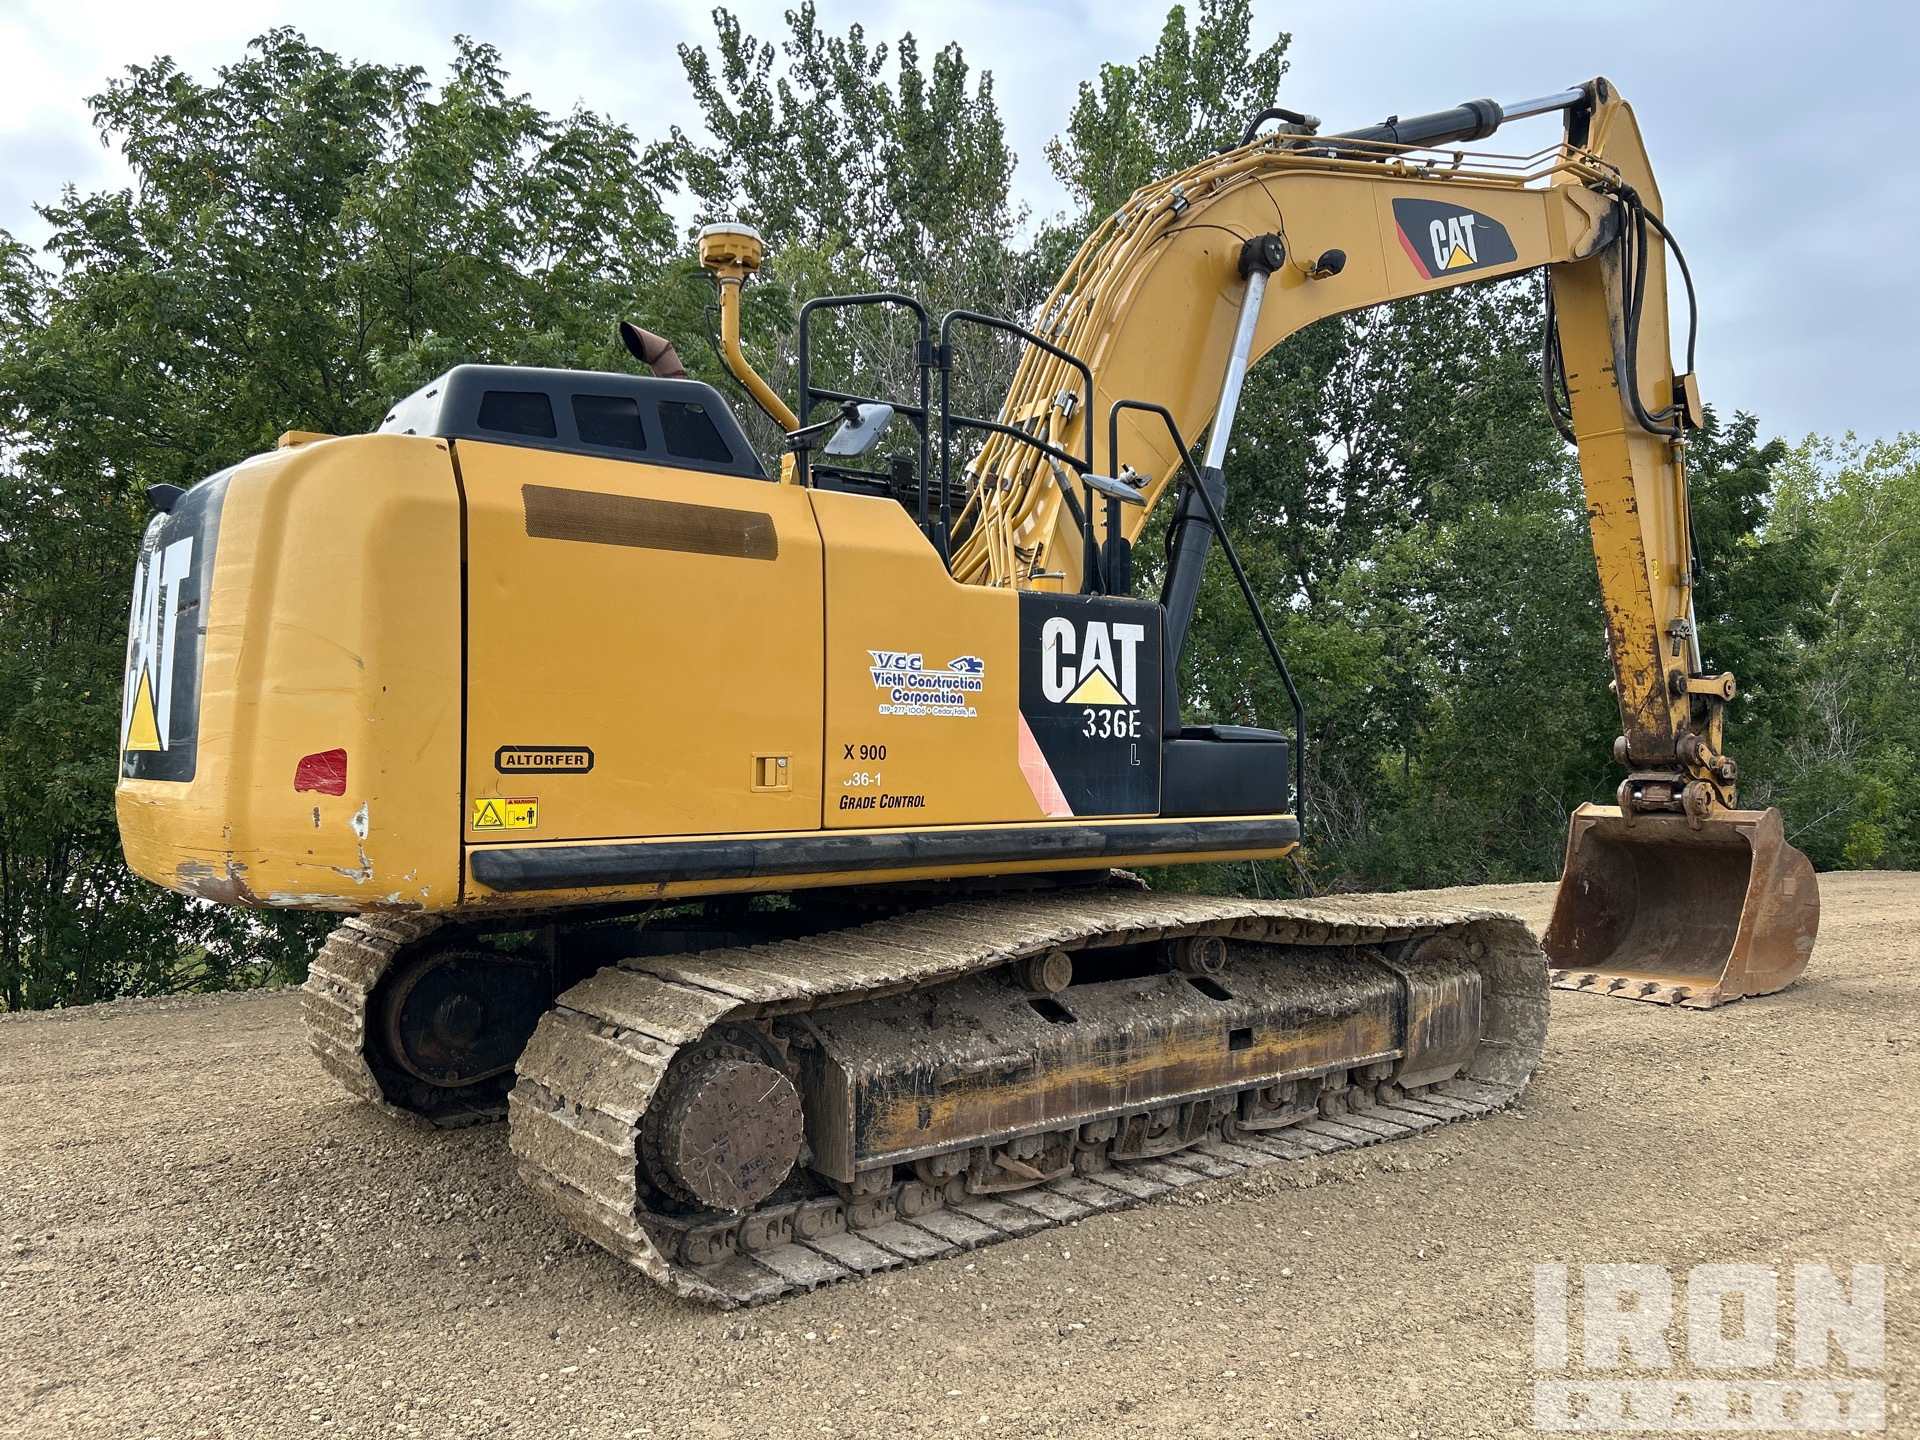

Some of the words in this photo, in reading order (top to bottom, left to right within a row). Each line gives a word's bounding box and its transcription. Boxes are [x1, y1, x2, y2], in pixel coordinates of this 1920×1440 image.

[1429, 214, 1478, 271] CAT
[1042, 617, 1144, 705] CAT
[873, 672, 904, 687] Vieth
[907, 674, 982, 690] Construction
[892, 688, 964, 706] Corporation
[880, 705, 926, 715] 319-277-1006
[1082, 708, 1141, 739] 336E
[506, 755, 584, 765] ALTORFER
[843, 744, 855, 760] X
[859, 744, 887, 761] 900
[1131, 743, 1141, 766] L
[839, 795, 877, 810] GRADE
[879, 793, 926, 809] CONTROL
